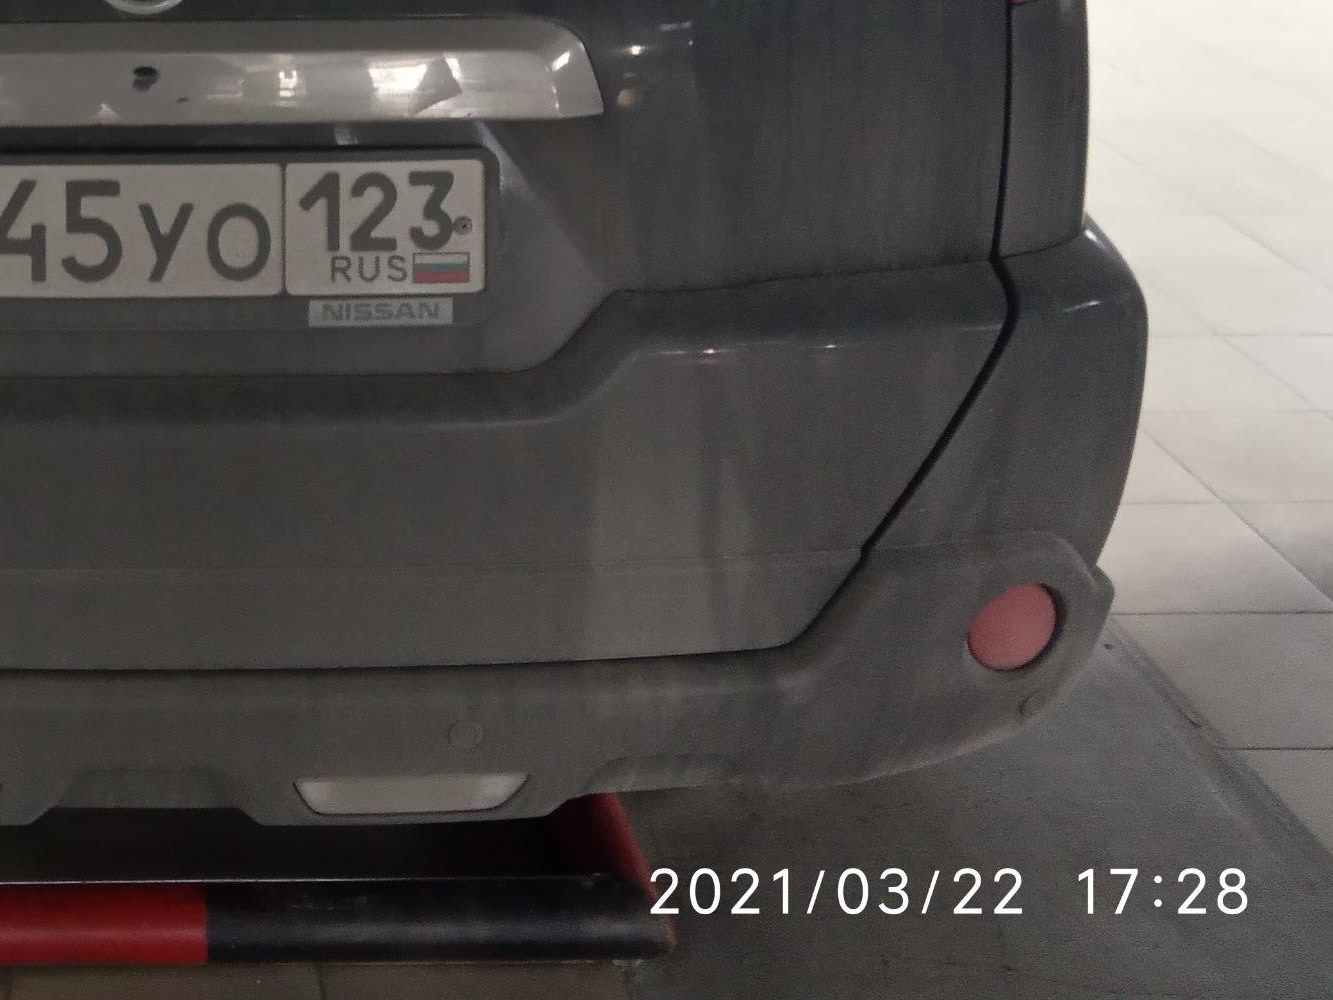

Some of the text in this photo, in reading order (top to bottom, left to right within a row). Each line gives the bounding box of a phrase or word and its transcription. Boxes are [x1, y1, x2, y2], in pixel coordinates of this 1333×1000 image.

[299, 171, 456, 253] 123
[330, 255, 409, 282] RUS
[322, 303, 440, 322] NISSAN
